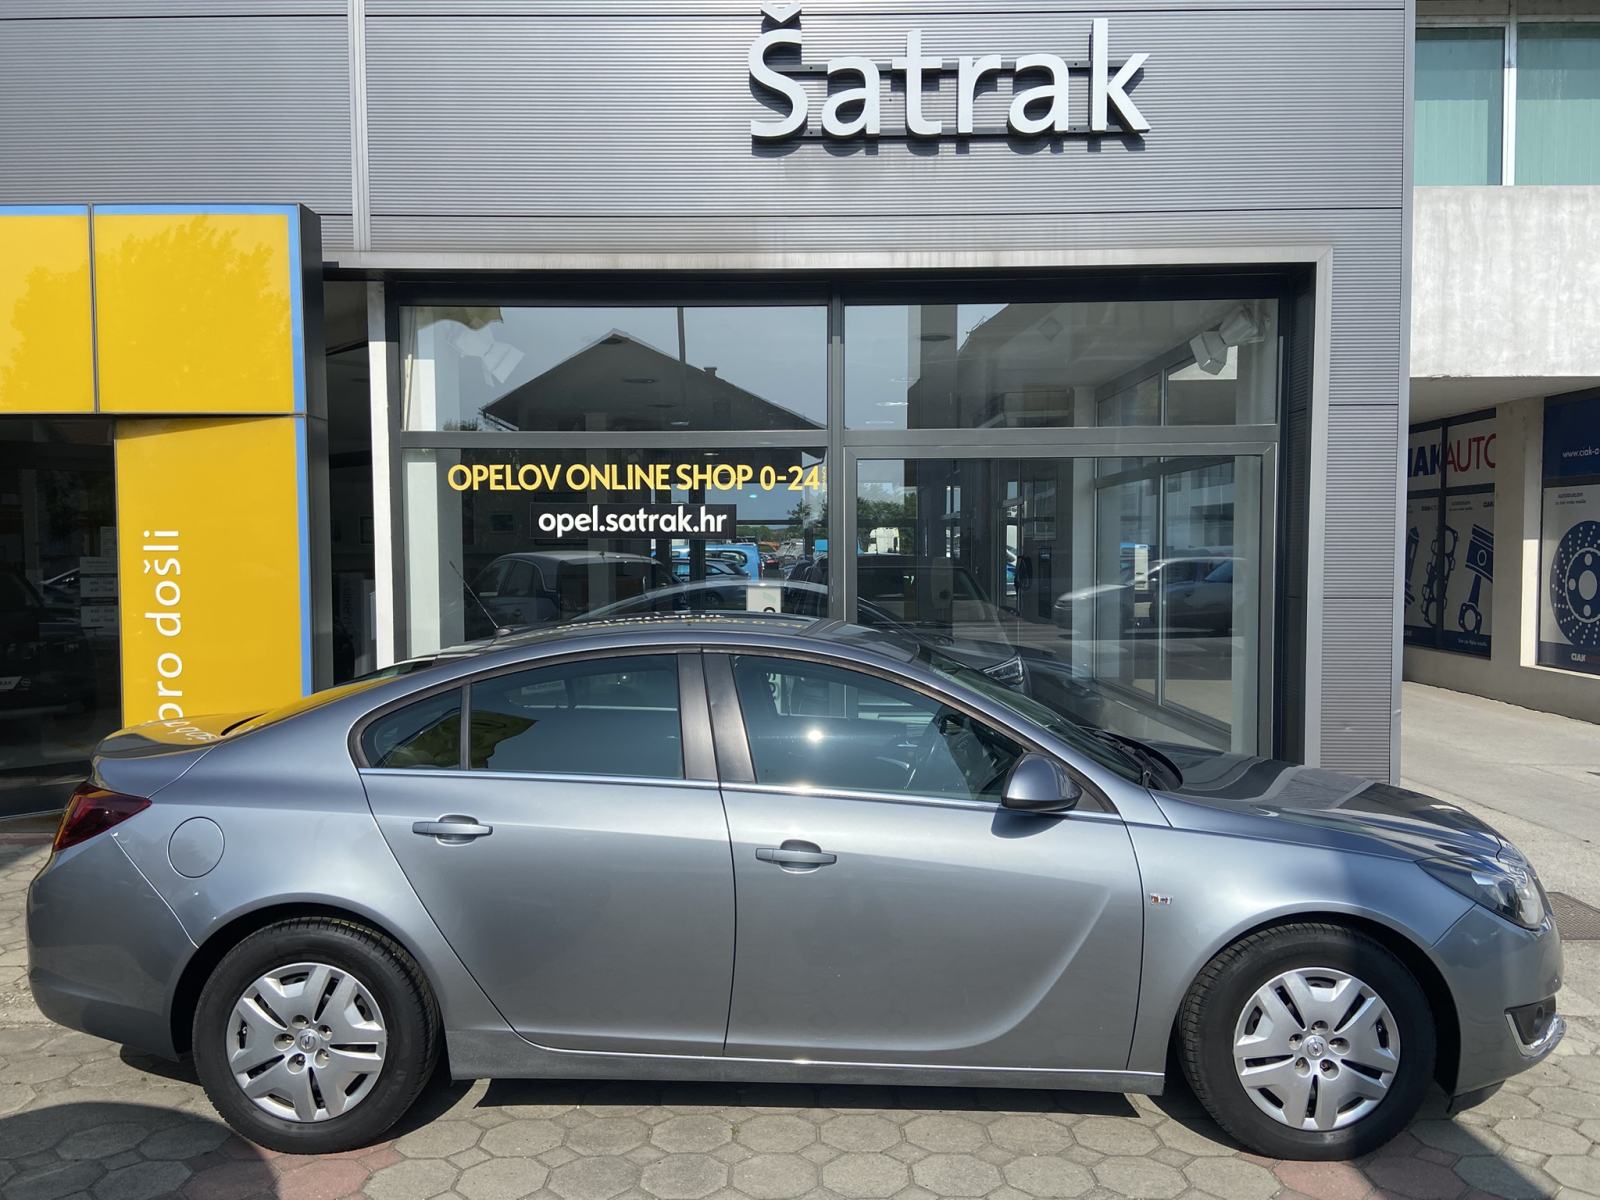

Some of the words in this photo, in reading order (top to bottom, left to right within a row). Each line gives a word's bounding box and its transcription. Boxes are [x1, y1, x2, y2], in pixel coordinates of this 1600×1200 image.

[748, 1, 1151, 138] Šatrak
[447, 464, 561, 491] OPELOV
[566, 464, 671, 491] ONLINE
[676, 464, 753, 491] SHOP
[759, 465, 820, 491] 0-24
[538, 505, 728, 538] opel.satrak.hr
[143, 530, 181, 637] došli
